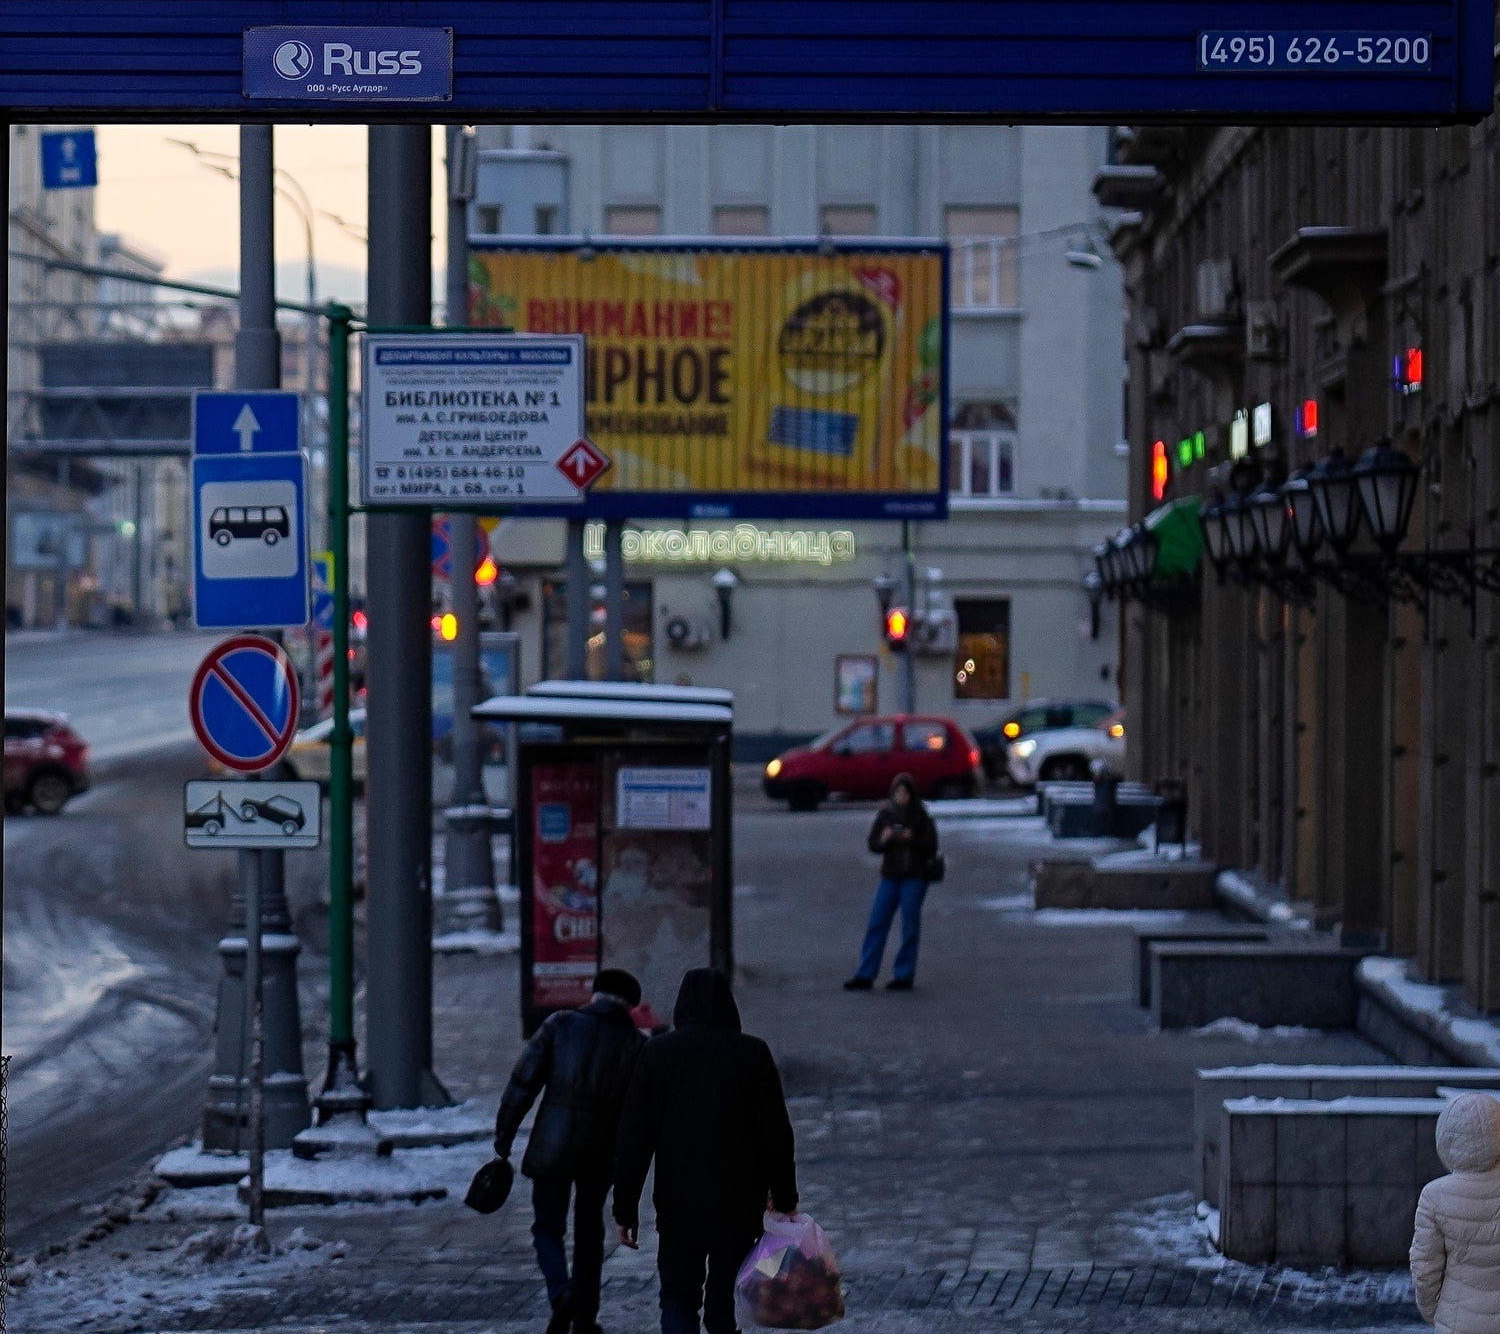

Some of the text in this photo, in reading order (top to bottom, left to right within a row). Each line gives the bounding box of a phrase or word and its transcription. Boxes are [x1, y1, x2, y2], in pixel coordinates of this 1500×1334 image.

[1200, 33, 1430, 67] (495) 626-5200
[322, 42, 423, 77] Russ
[306, 83, 326, 94] ООО
[526, 298, 732, 339] ВНИМАНИЕ!
[384, 390, 520, 408] БИБЛИОТЕКА
[550, 390, 561, 407] 1
[418, 427, 529, 444] ДЕТСКИЙ ЦЕНТР
[461, 444, 543, 458] АНДЕРСЕНА
